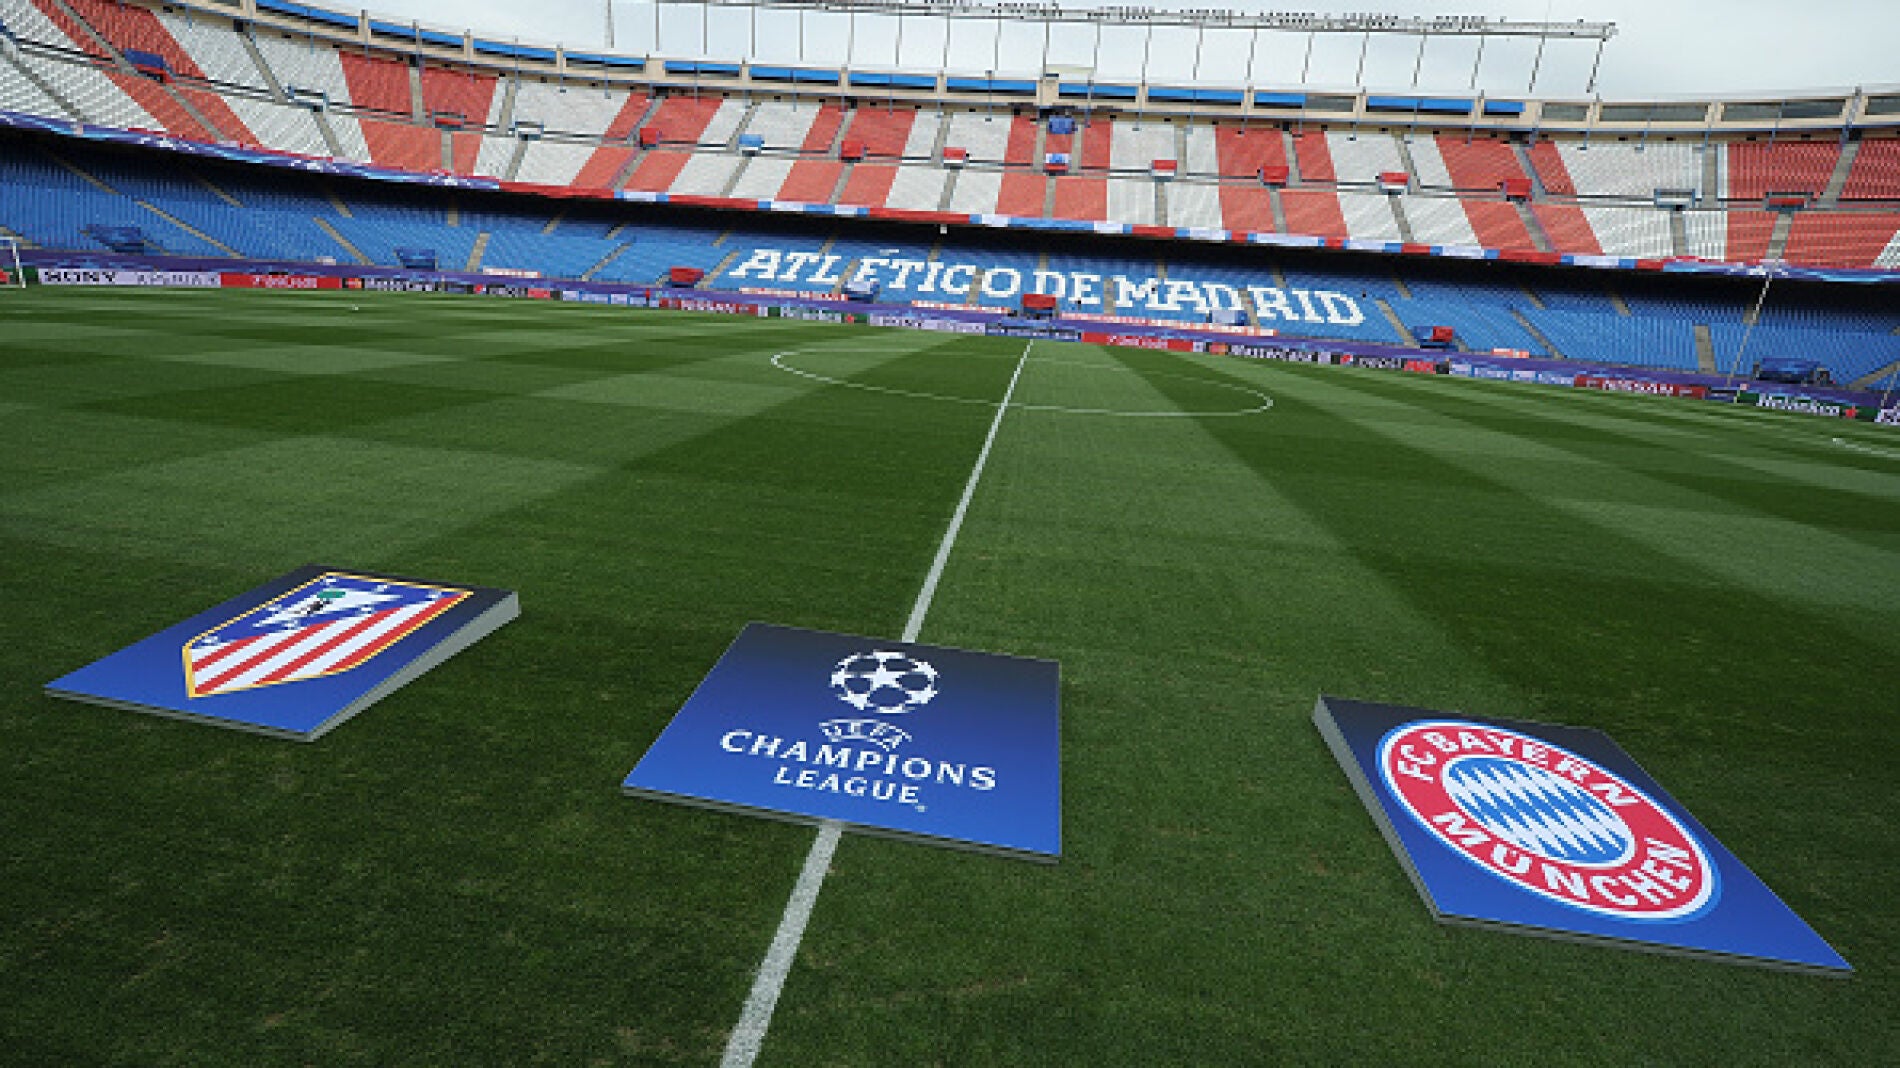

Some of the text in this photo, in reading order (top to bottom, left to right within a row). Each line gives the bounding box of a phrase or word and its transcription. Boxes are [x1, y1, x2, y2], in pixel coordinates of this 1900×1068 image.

[44, 270, 117, 284] SONY
[729, 248, 1021, 298] ATLÉTICO
[1033, 269, 1102, 306] DE
[1114, 276, 1366, 326] MADRID
[719, 729, 997, 792] CHAMPIONS
[773, 766, 919, 804] LEAGUE
[1397, 731, 1639, 807] FC BAYERN
